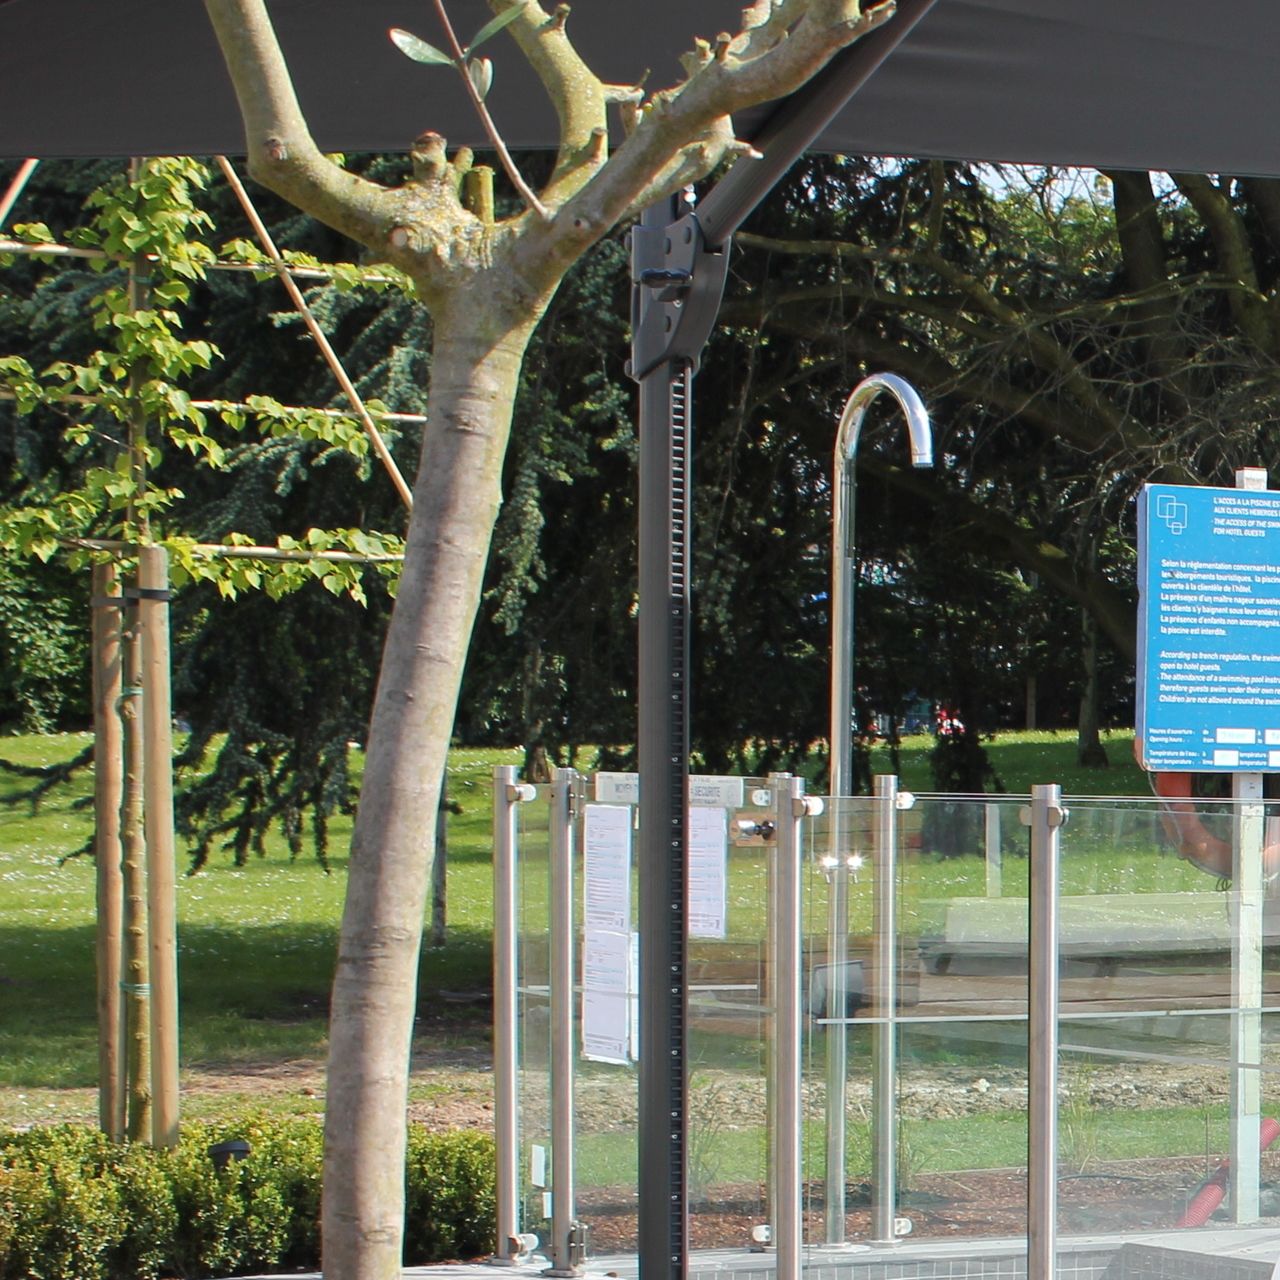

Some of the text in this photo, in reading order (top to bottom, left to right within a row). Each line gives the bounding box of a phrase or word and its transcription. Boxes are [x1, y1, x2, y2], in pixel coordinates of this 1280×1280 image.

[1161, 560, 1179, 568] Selon
[1233, 563, 1266, 572] concernant
[1267, 564, 1276, 572] les
[1170, 593, 1198, 603] présence
[1199, 594, 1212, 602] d'un
[1213, 595, 1233, 603] maître
[1234, 598, 1255, 606] nageur
[1171, 604, 1191, 613] clients
[1192, 605, 1201, 615] s'y
[1202, 606, 1228, 616] baignent
[1244, 607, 1256, 615] leur
[1257, 608, 1278, 616] entière
[1169, 616, 1197, 626] présence
[1198, 617, 1226, 625] d'enfants
[1168, 626, 1189, 636] piscine
[1160, 650, 1191, 661] According
[1183, 662, 1199, 670] hotel
[1172, 673, 1206, 682] attendance
[1219, 674, 1250, 684] swimming
[1250, 675, 1264, 685] pool
[1160, 684, 1188, 692] therefore
[1188, 684, 1209, 694] guests
[1210, 685, 1227, 693] swim
[1227, 686, 1245, 694] under
[1246, 686, 1260, 694] their
[1159, 694, 1185, 703] Children
[1208, 696, 1232, 704] allowed
[1232, 696, 1254, 704] around
